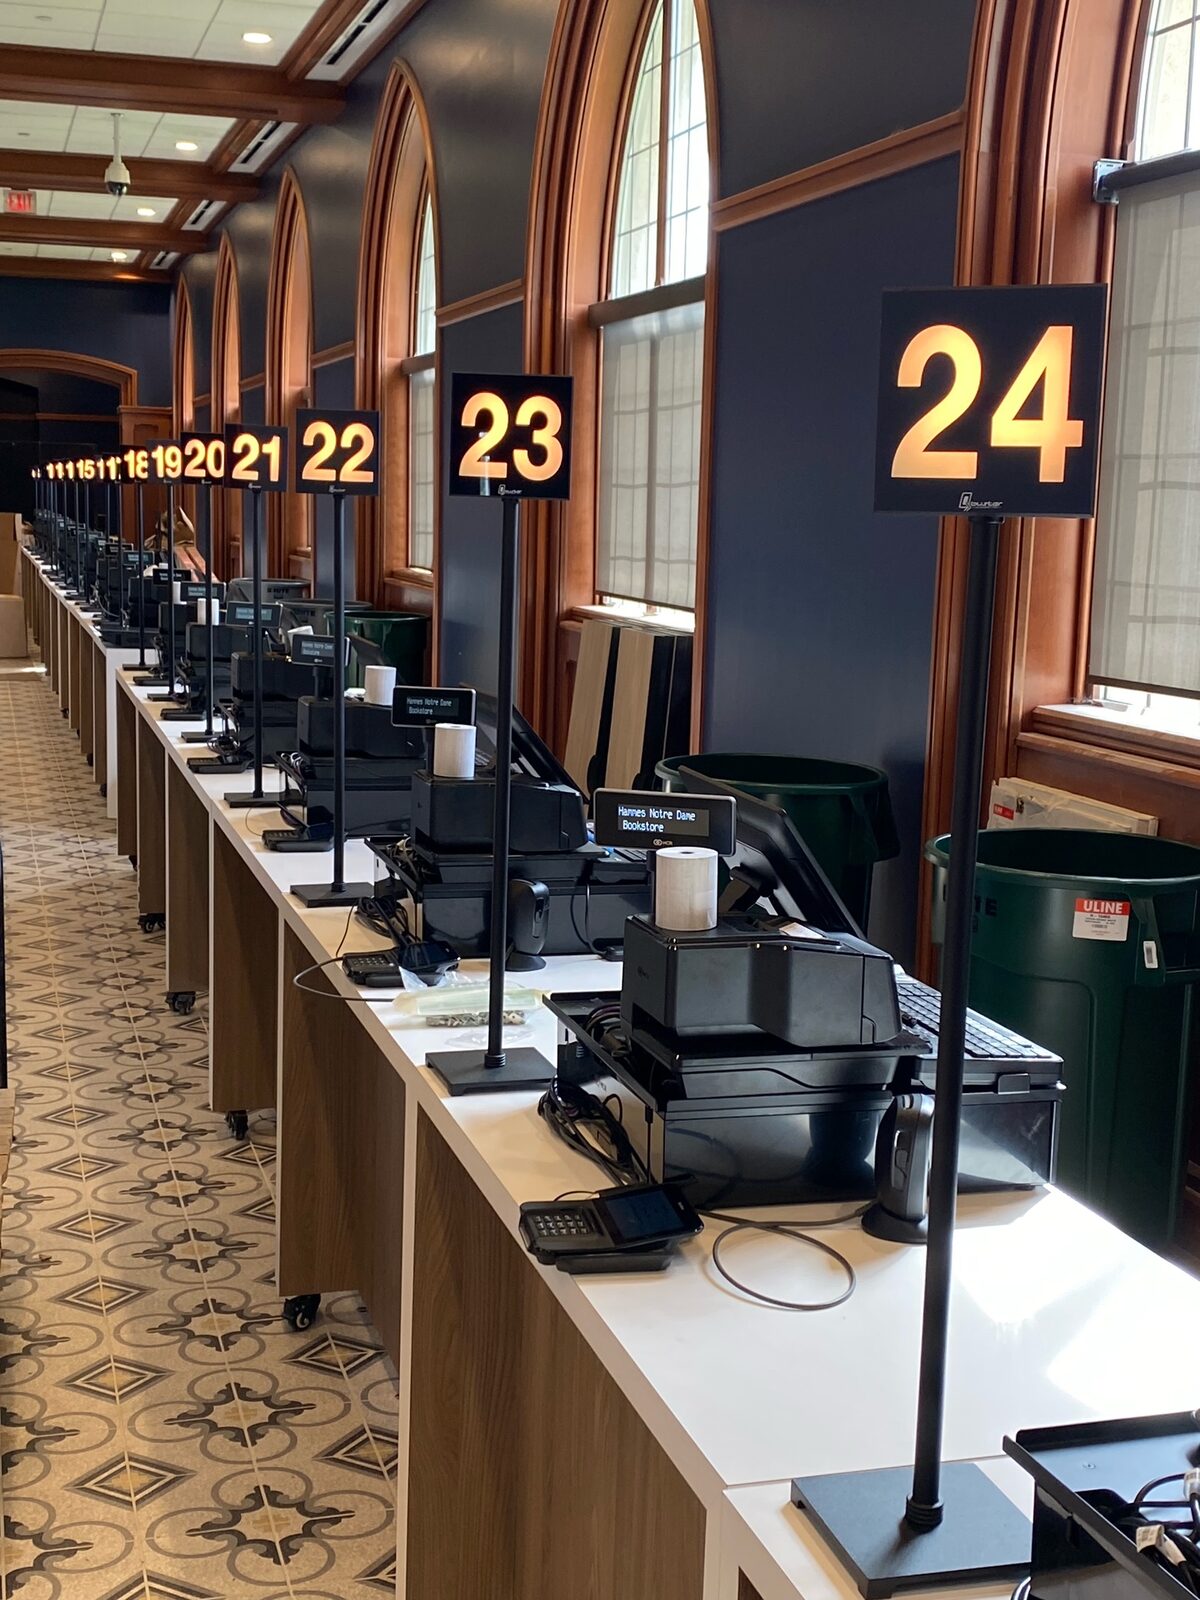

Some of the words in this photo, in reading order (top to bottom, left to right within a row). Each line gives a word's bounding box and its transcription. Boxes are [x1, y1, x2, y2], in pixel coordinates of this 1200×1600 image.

[891, 324, 1084, 483] 24
[302, 421, 374, 483] 22
[458, 392, 563, 481] 23
[76, 459, 95, 479] 15
[123, 449, 149, 479] 18
[151, 445, 182, 478] 19
[184, 439, 225, 478] 20
[231, 433, 281, 482] 21
[622, 819, 665, 833] Bookstore
[649, 808, 673, 820] Notre
[676, 809, 696, 822] Dame
[1083, 900, 1123, 914] ULINE
